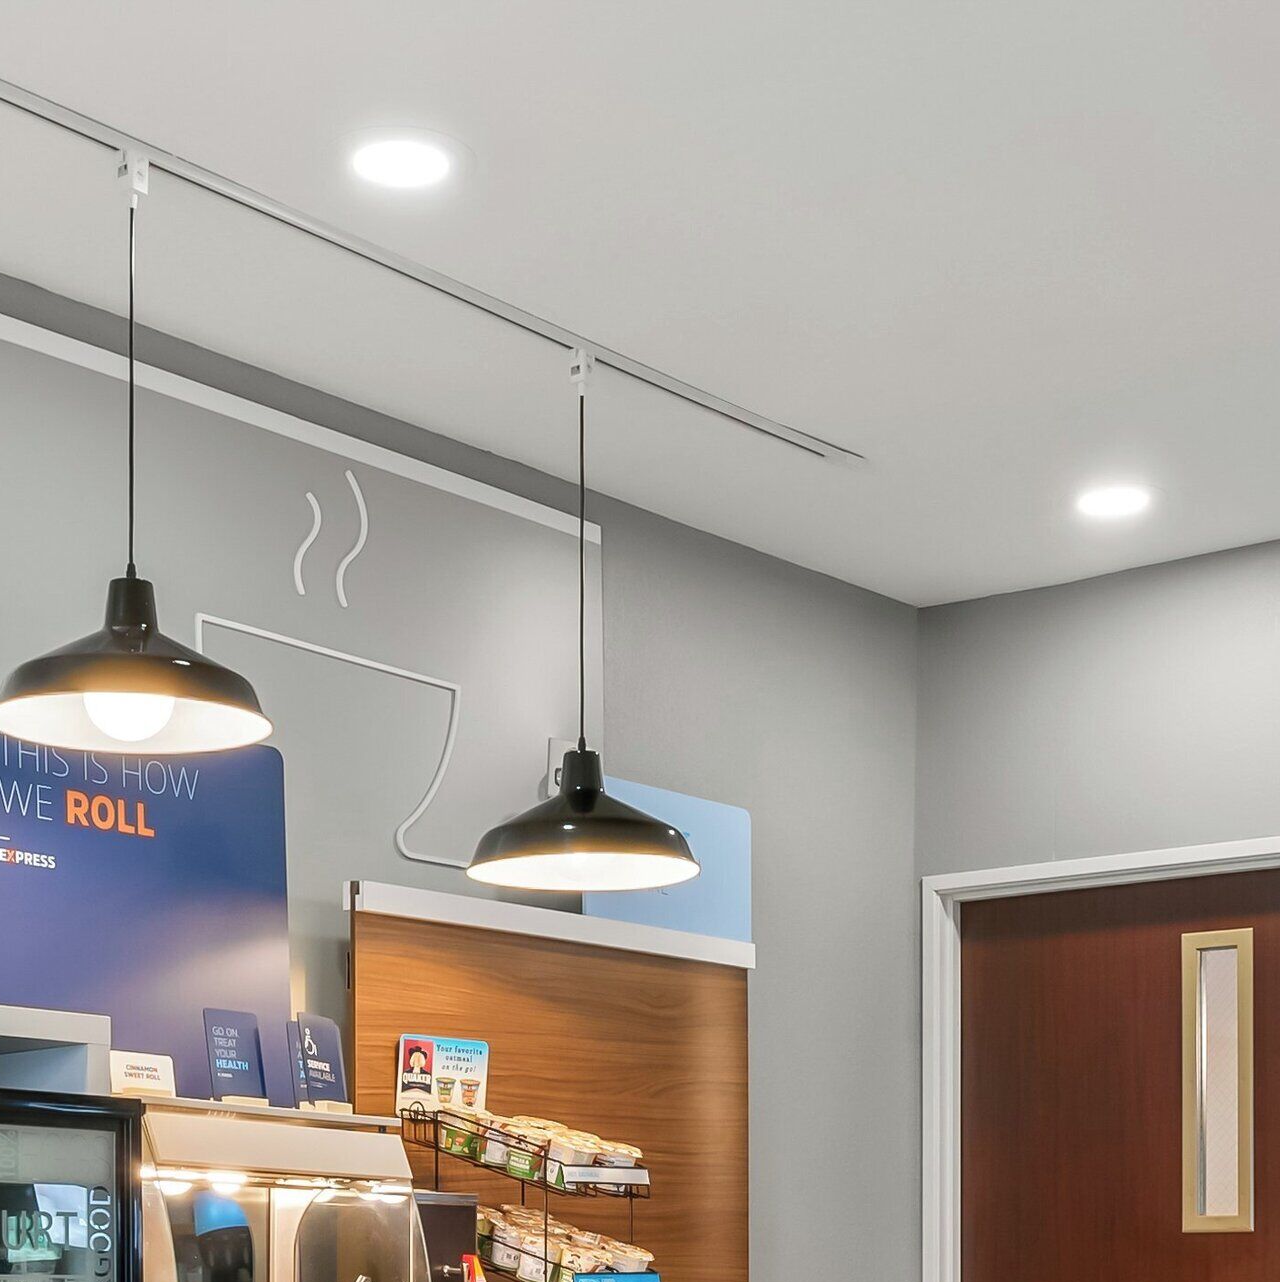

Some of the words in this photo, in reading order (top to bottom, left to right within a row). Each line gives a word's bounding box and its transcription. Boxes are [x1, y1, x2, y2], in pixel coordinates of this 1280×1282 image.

[1, 733, 69, 778] THIS
[84, 747, 108, 785] IS
[123, 760, 199, 800] HOW
[65, 789, 155, 838] ROLL
[212, 1025, 224, 1036] GO
[213, 1037, 237, 1047] TREAT
[214, 1049, 237, 1059] YOUR
[436, 1044, 452, 1053] Your
[454, 1045, 483, 1056] favorite
[215, 1058, 249, 1071] HEALTH
[445, 1055, 473, 1063] oatmeal
[403, 1072, 432, 1085] QUAKER
